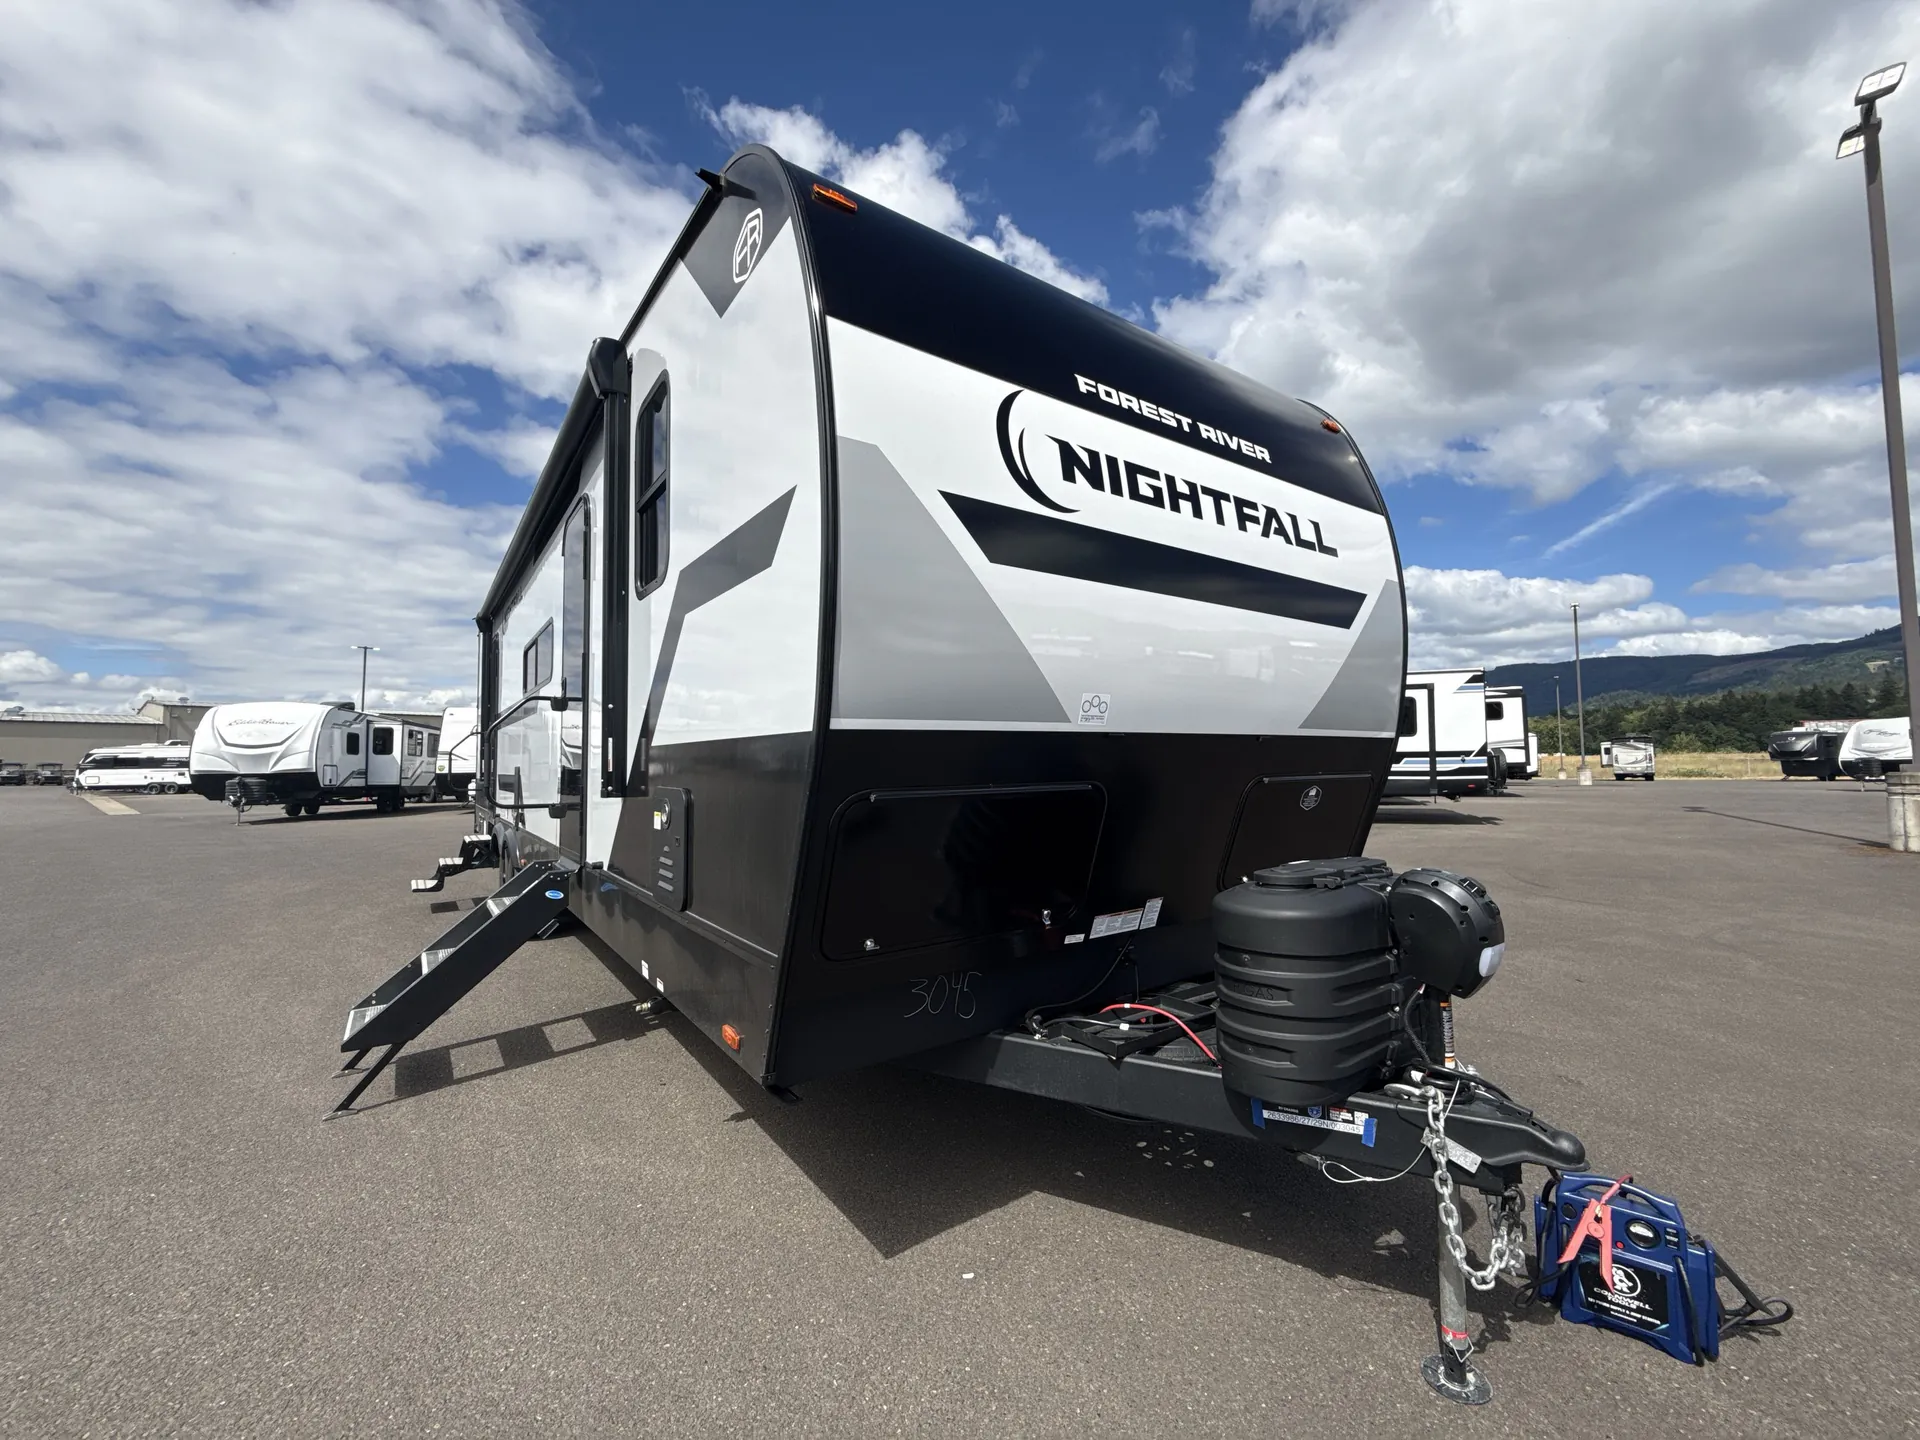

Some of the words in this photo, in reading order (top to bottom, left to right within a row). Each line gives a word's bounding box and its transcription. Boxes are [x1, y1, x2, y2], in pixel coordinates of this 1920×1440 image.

[1073, 373, 1192, 432] FOREST
[1196, 421, 1272, 464] RIVER
[1045, 433, 1339, 558] NIGHTFALL
[903, 971, 983, 1019] 3045
[1244, 984, 1274, 1001] GAS
[1607, 1295, 1637, 1310] TOOLS
